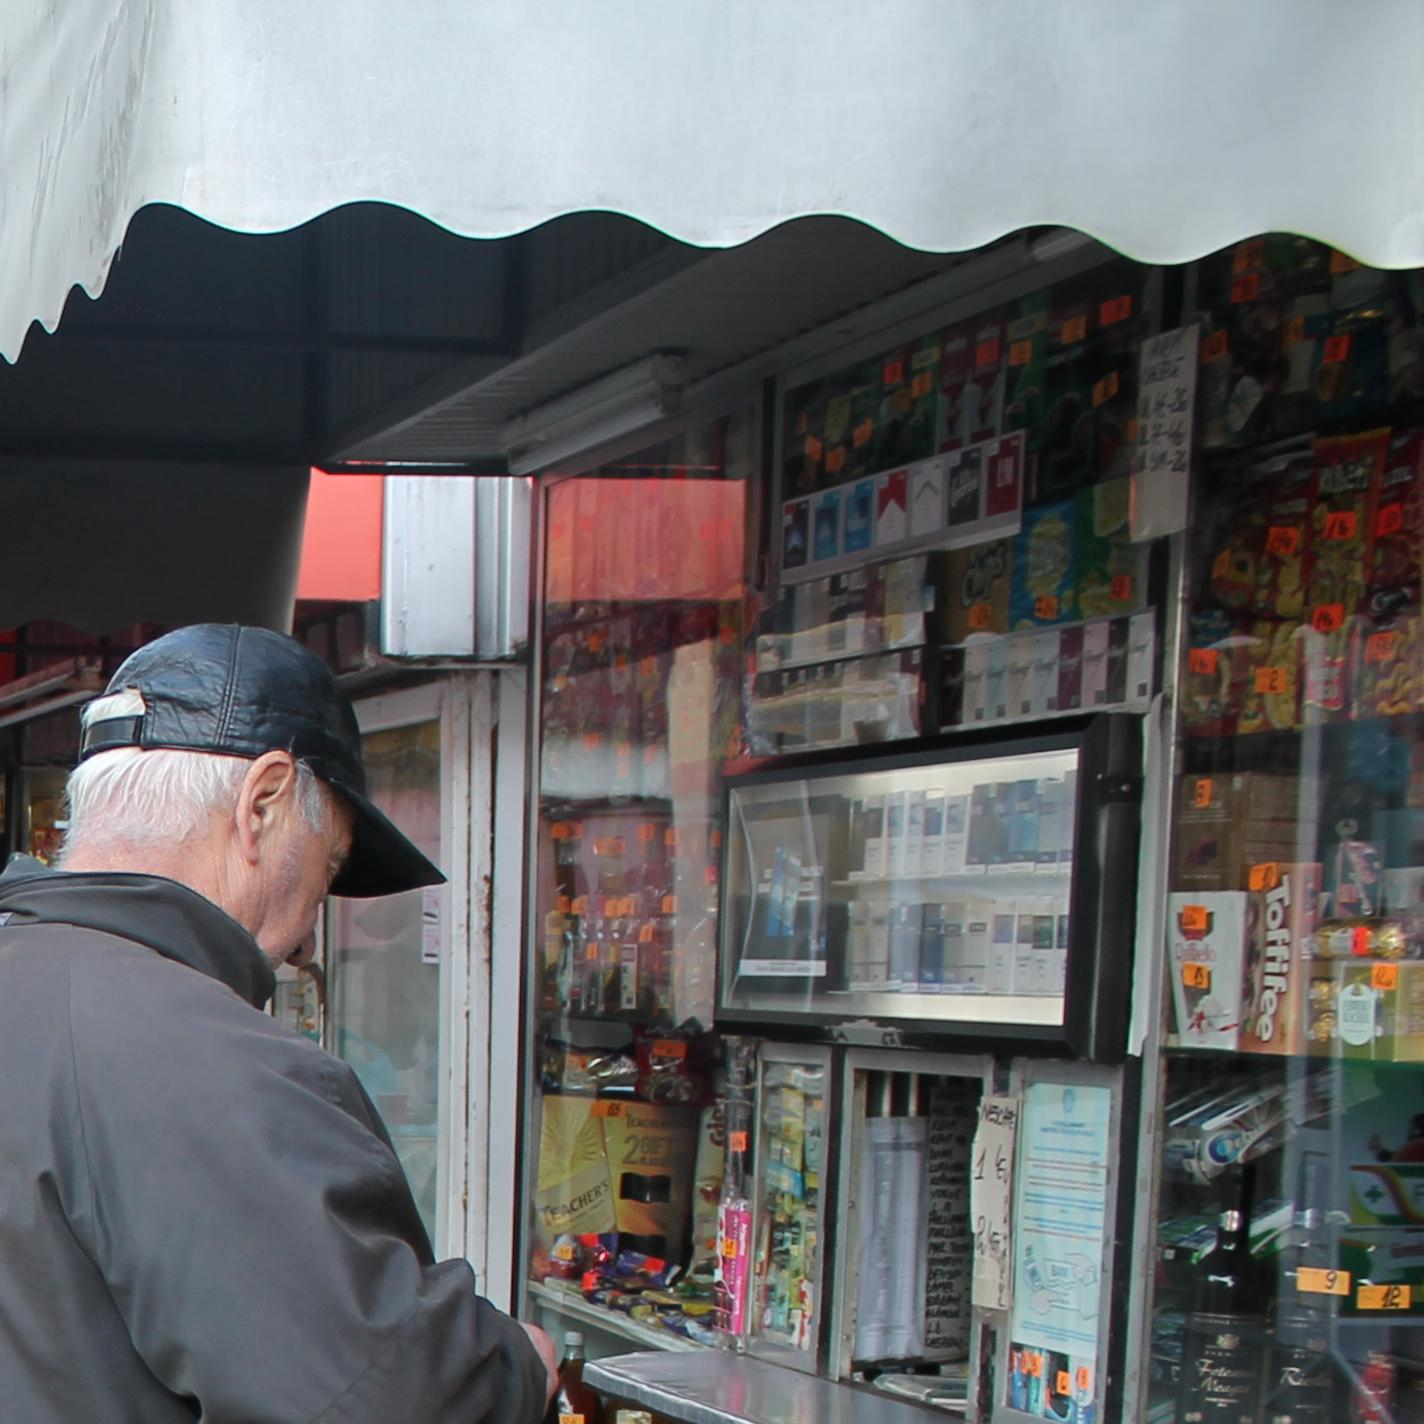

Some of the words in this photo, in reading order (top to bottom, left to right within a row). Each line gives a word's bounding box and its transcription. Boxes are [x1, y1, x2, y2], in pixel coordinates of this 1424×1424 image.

[1256, 874, 1292, 1042] Toffifee
[1325, 1270, 1339, 1290] 9
[1381, 1285, 1402, 1308] 12
